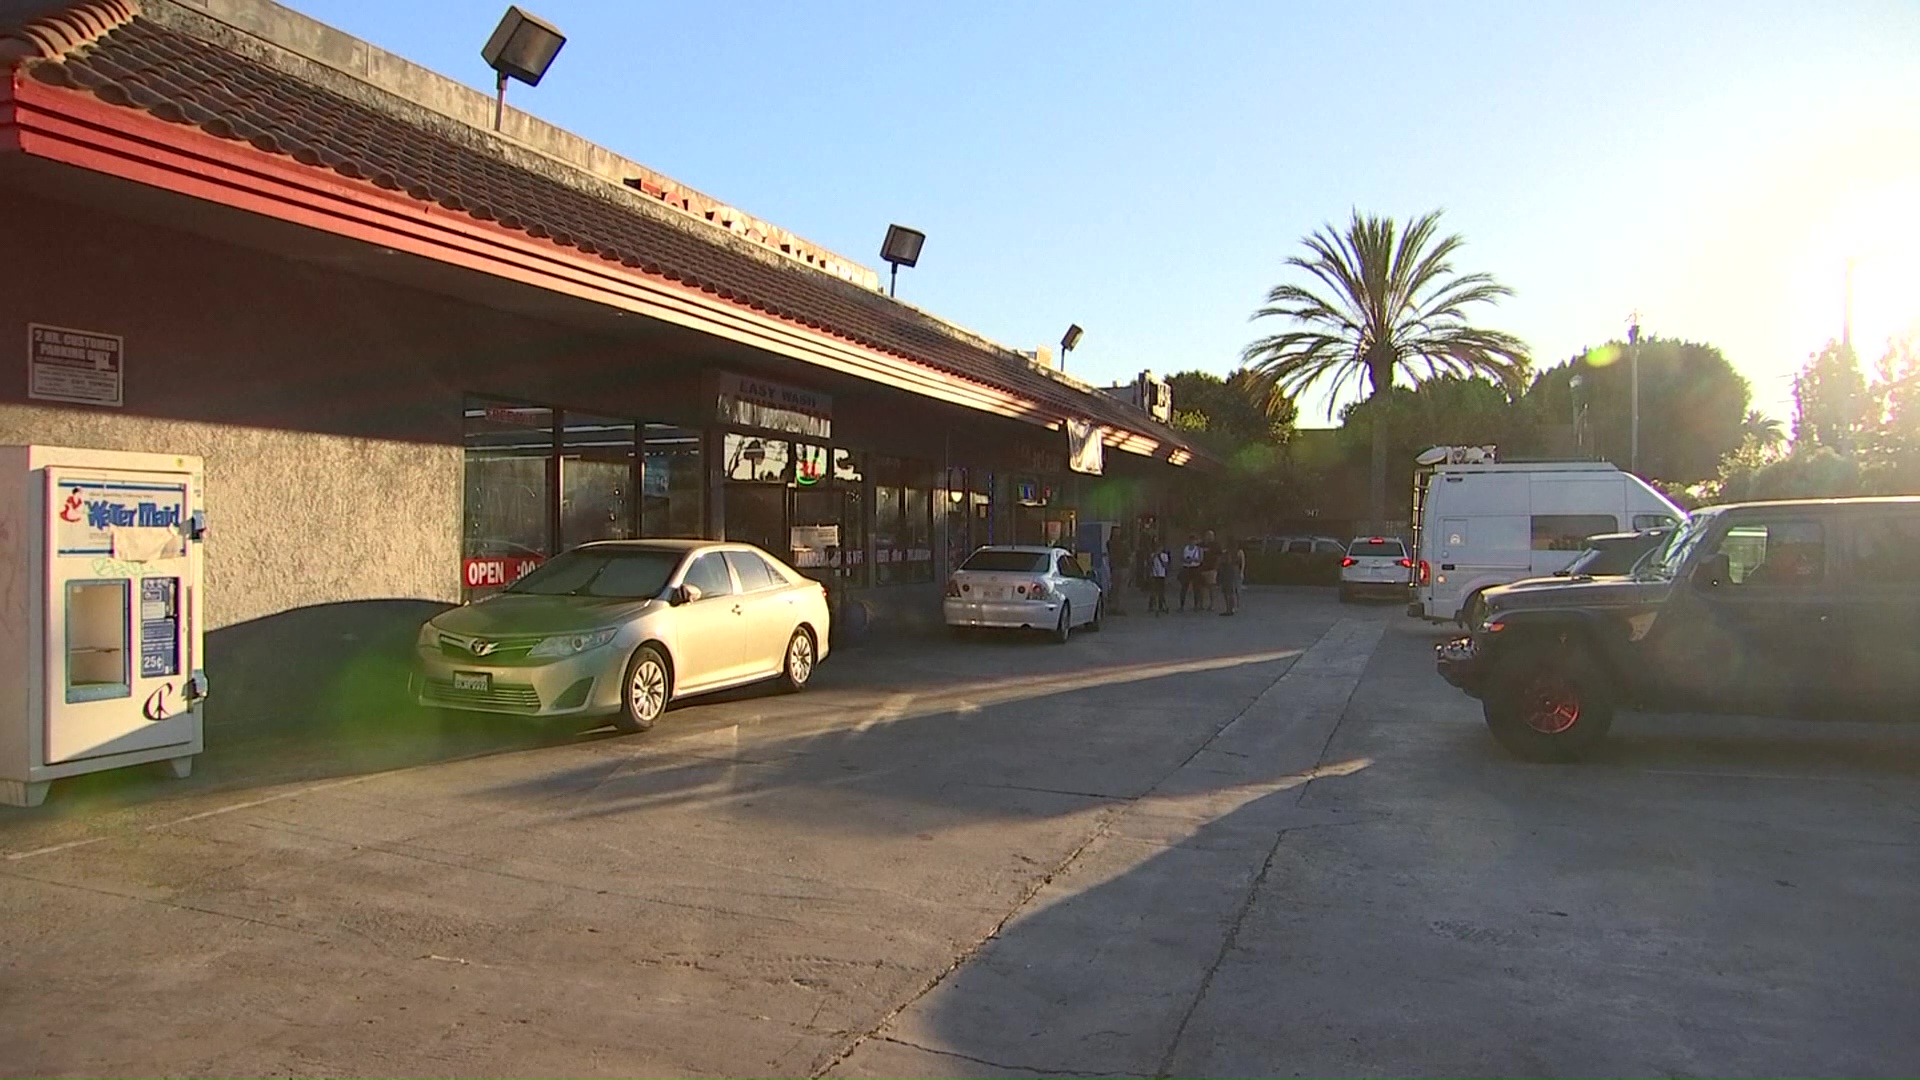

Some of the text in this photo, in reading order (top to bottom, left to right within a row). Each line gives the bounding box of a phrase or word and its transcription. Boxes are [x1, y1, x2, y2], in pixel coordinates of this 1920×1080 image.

[34, 329, 43, 342] 2
[64, 334, 118, 352] CUSTOMER
[39, 343, 86, 360] PARKING
[739, 379, 816, 408] EASY WASH
[138, 502, 180, 528] Maid
[468, 561, 505, 585] OPEN
[143, 655, 163, 670] 25¢
